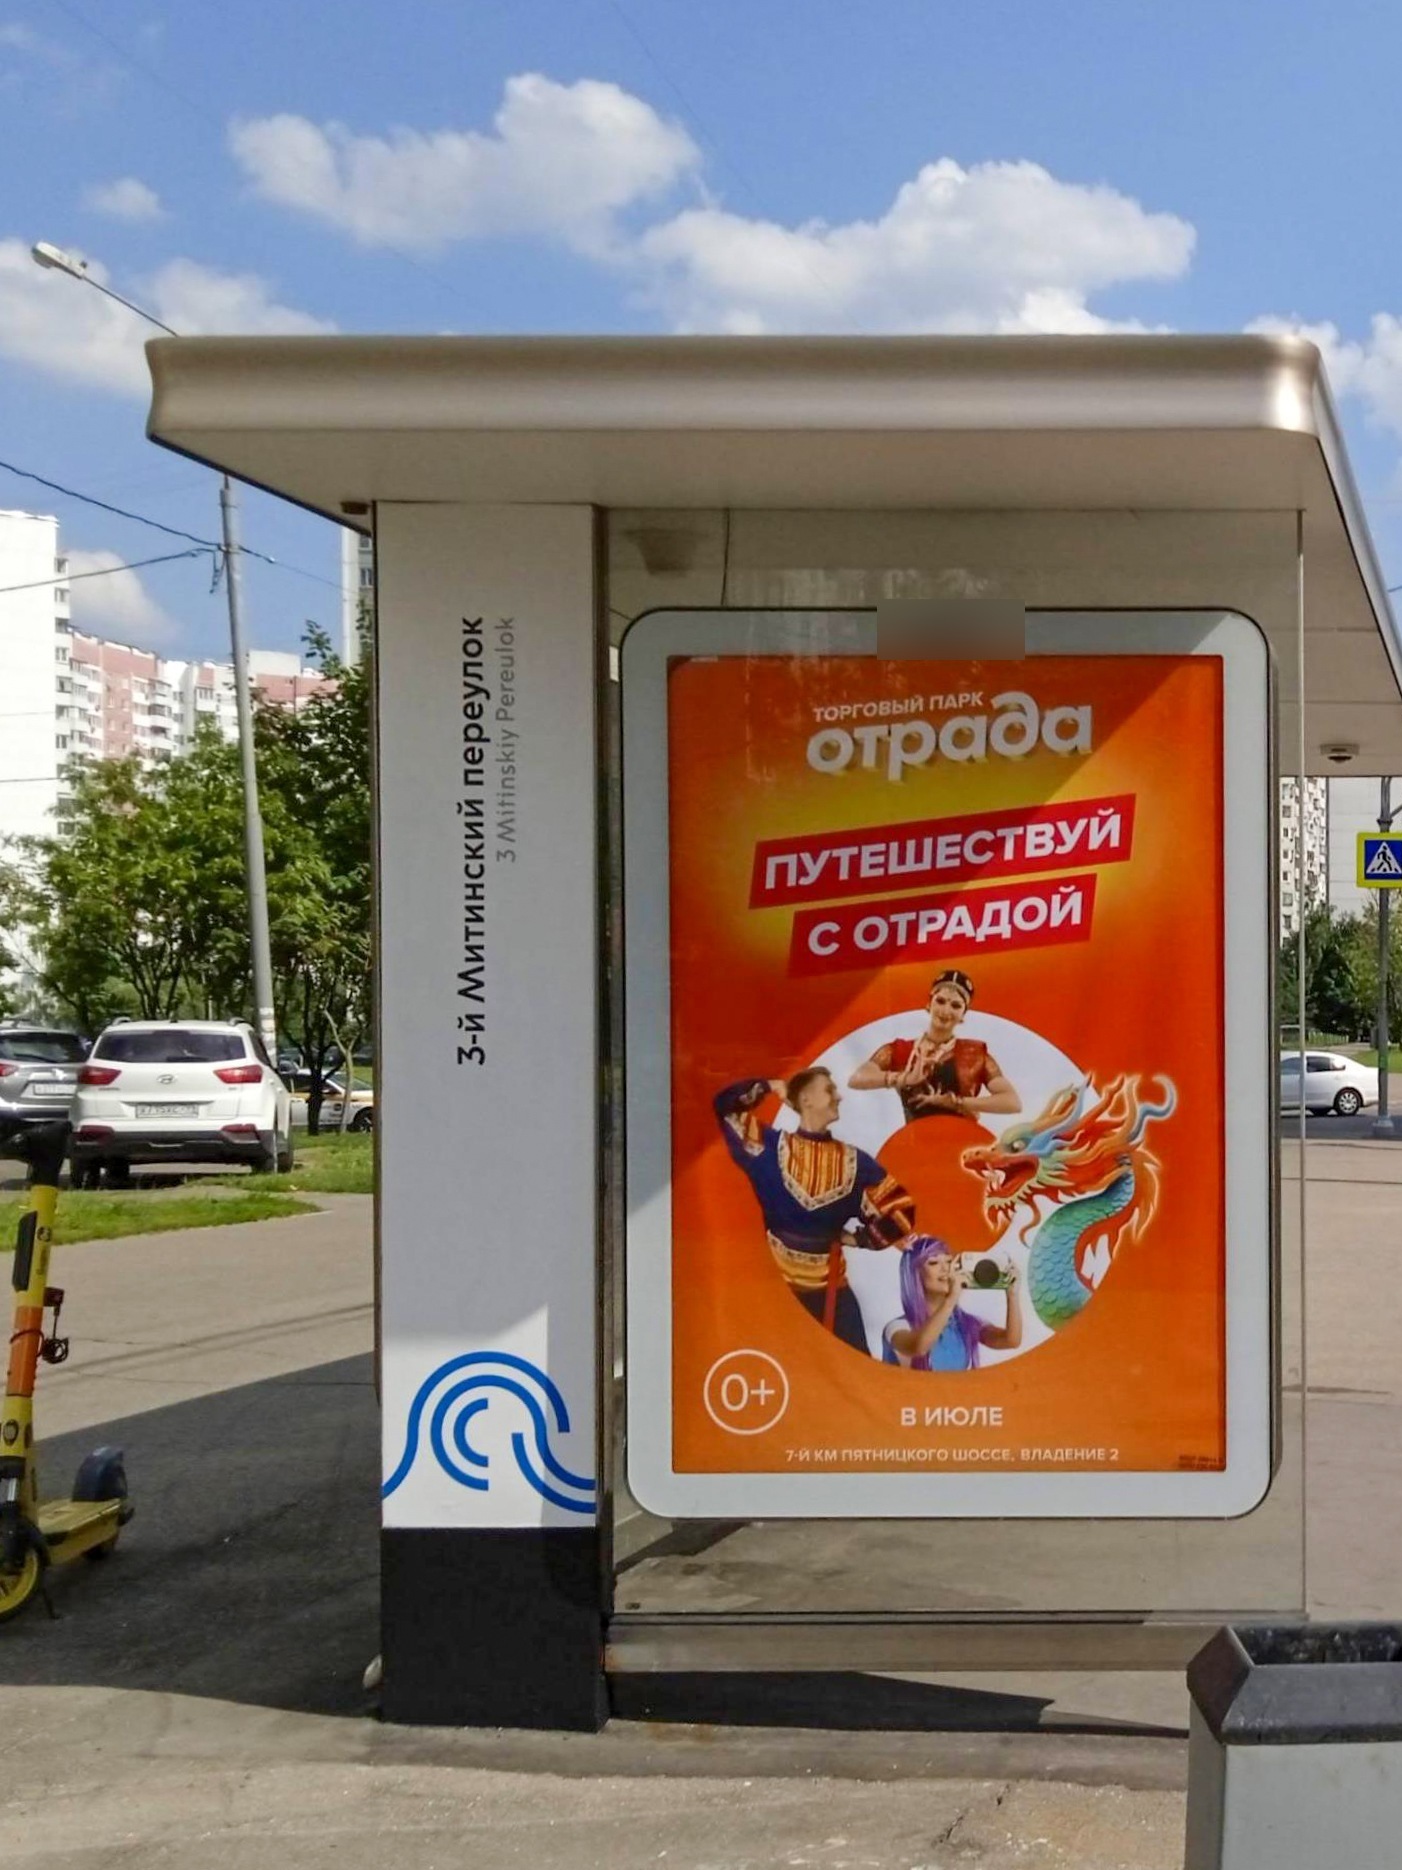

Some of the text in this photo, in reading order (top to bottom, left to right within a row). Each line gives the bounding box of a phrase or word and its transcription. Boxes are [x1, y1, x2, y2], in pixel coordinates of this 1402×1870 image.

[495, 617, 520, 863] 3 Mitinskiy Pereulok
[806, 691, 1093, 781] отрада
[813, 691, 984, 723] ТОРГОВЫЙ ПАРК
[456, 616, 490, 1066] 3-й Митинский переулок
[764, 806, 1122, 890] ПУТЕШЕСТВУЙ
[808, 884, 1082, 956] С ОТРАДОЙ
[720, 1373, 776, 1411] 0+
[900, 1406, 1004, 1427] В ИЮЛЕ
[786, 1446, 810, 1462] 7-Й
[814, 1449, 838, 1461] КМ
[841, 1448, 948, 1464] ПЯТНИЦКОГО
[1020, 1448, 1105, 1463] ВЛАДЕНИЕ
[1108, 1448, 1120, 1461] 2
